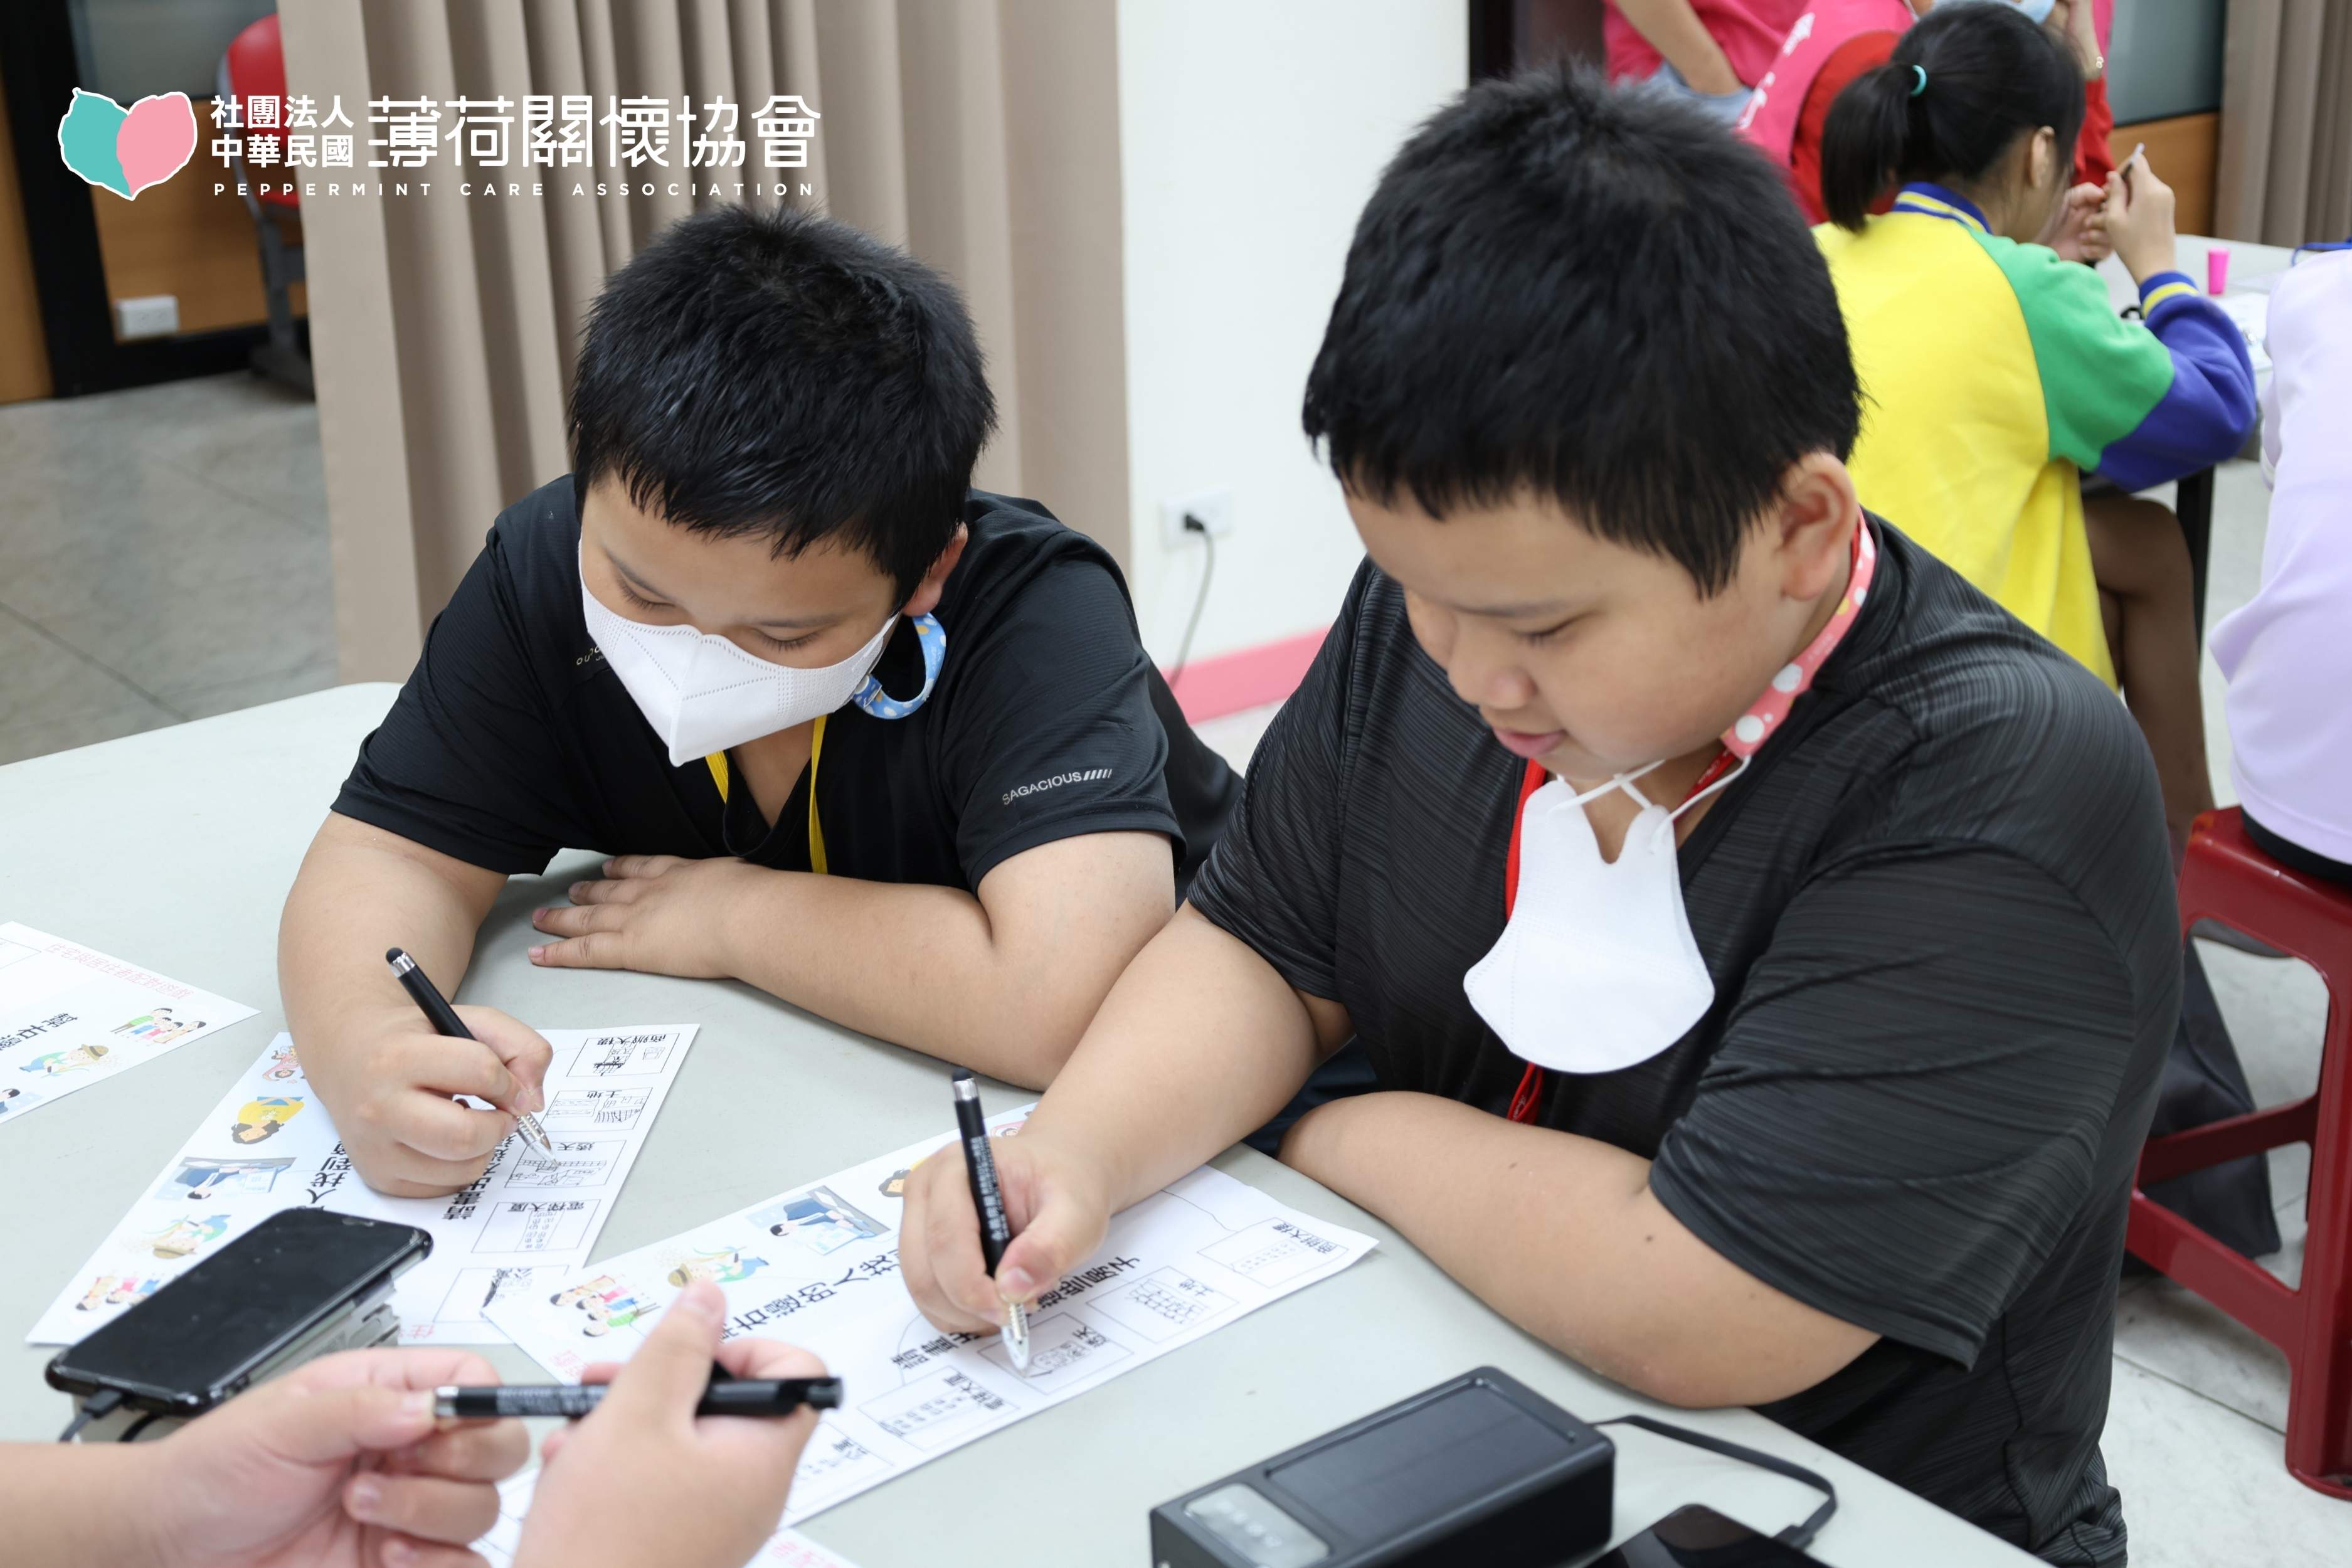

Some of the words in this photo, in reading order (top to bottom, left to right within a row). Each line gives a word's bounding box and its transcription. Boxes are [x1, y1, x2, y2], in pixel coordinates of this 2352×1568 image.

[1002, 771, 1082, 805] SAGACIOUS
[586, 1089, 623, 1099] 土地
[557, 1142, 595, 1152] 透天
[1178, 1278, 1215, 1298] 土地
